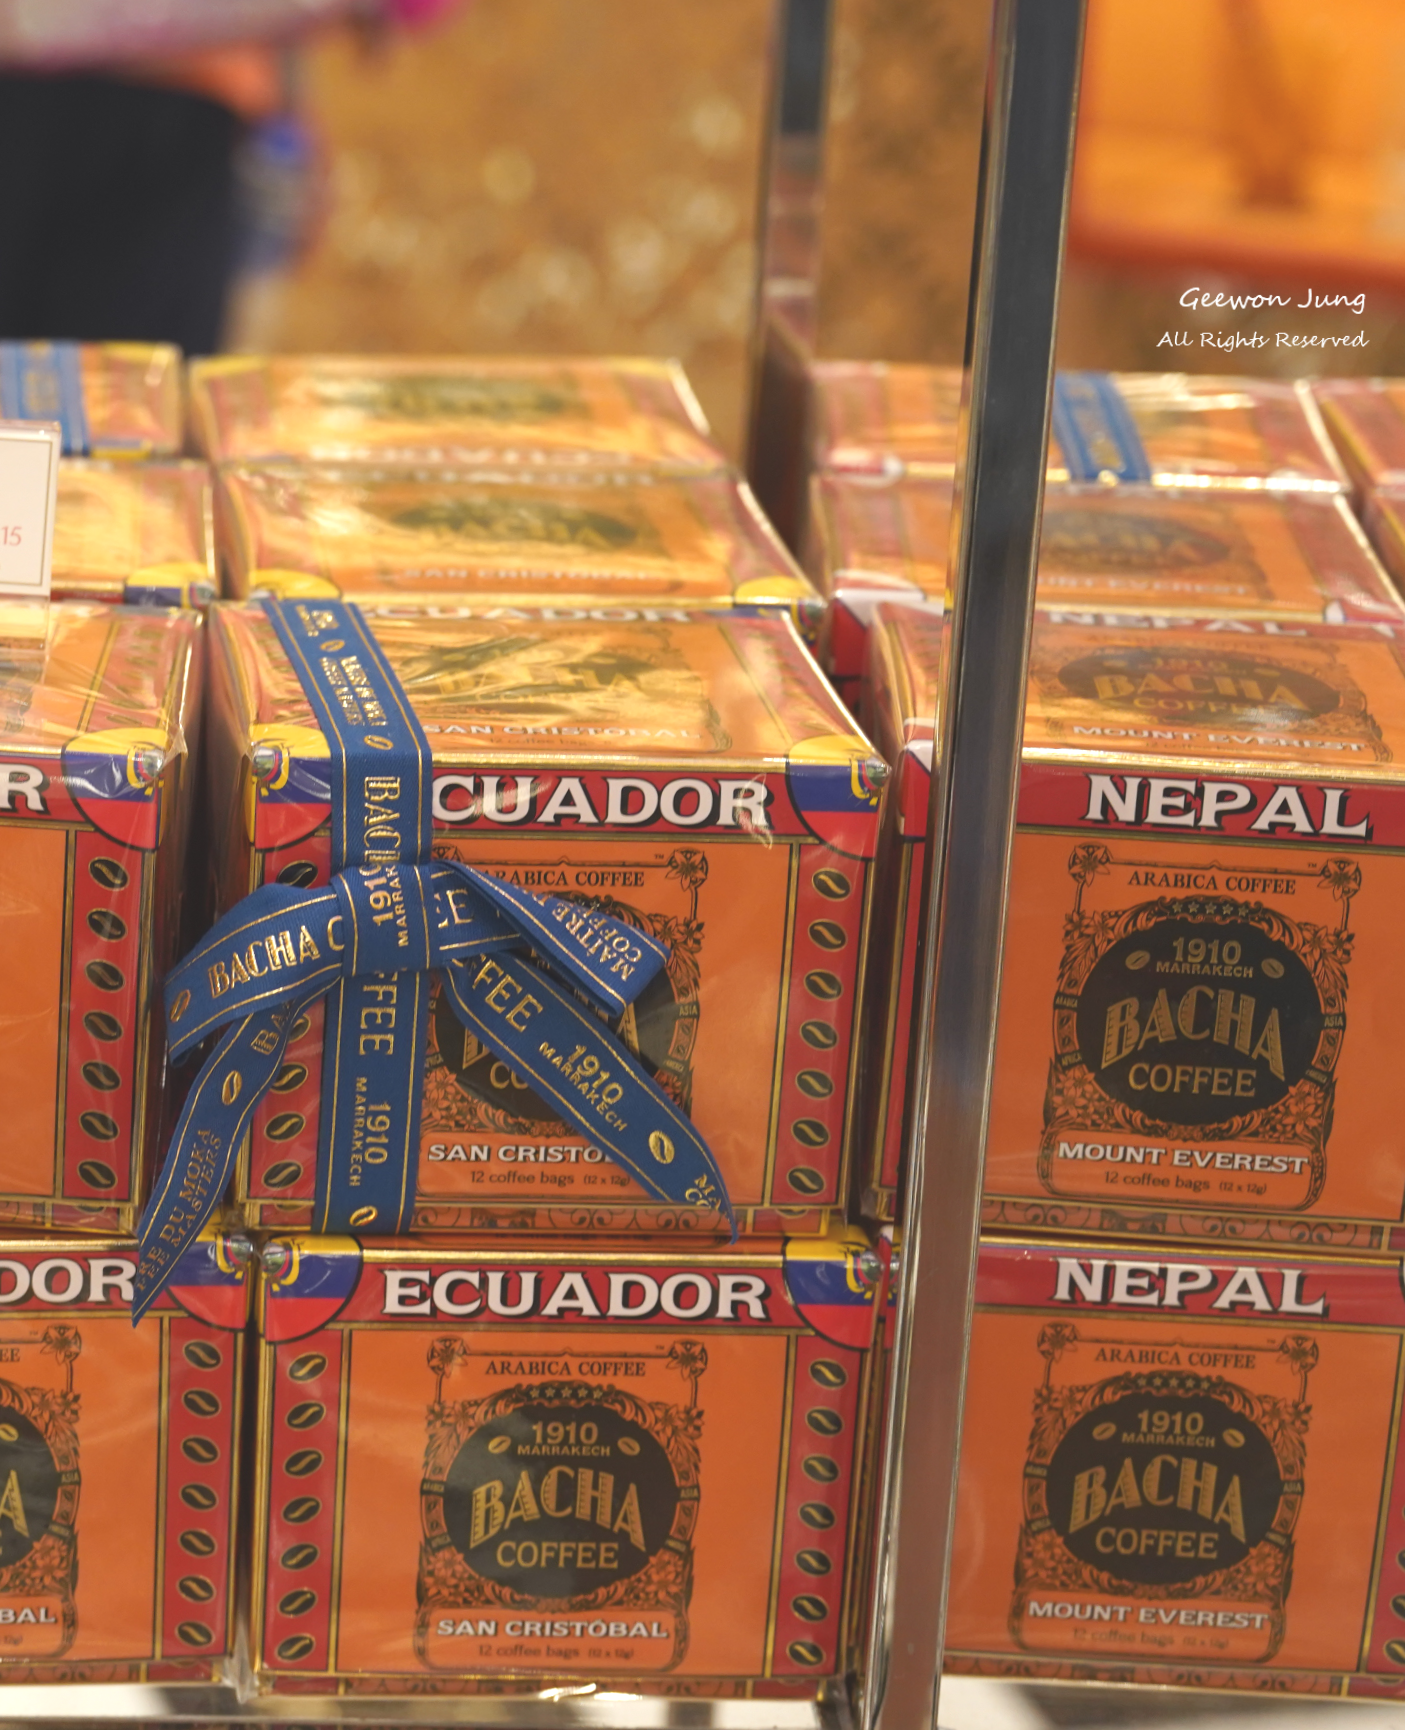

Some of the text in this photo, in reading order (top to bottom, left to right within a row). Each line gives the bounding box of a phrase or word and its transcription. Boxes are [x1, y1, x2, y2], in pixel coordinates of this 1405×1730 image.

[433, 773, 770, 829] CUADOR
[1085, 773, 1372, 840] NEPAL
[575, 871, 645, 888] COFFEE
[1128, 870, 1296, 896] ARABICA COFFEE
[207, 926, 321, 998] BACHA
[1172, 937, 1241, 965] 1910
[1156, 961, 1254, 978] MARRAKECH
[1101, 985, 1285, 1082] BACHA
[539, 1041, 628, 1131] MARRAKECH
[567, 1044, 624, 1104] 1910
[1128, 1063, 1257, 1097] COFFEE
[349, 1077, 368, 1187] MARRAKECH
[364, 1101, 392, 1164] 1910
[428, 1142, 612, 1163] SAN CRISTÓ
[1058, 1141, 1309, 1175] MOUNT EVEREST
[160, 1128, 211, 1241] DU MOKA
[171, 1132, 222, 1248] MASTERS
[471, 1170, 630, 1187] 12 coffee bags (12 12g)
[1104, 1171, 1119, 1185] 12
[1122, 1172, 1170, 1189] coffee
[1175, 1175, 1210, 1193] bags
[381, 1267, 772, 1321] ECUADOR
[1053, 1257, 1329, 1318] NEPAL
[485, 1360, 646, 1377] ARABICA COFFEE
[1094, 1347, 1256, 1370] ARABICA COFFEE
[532, 1421, 598, 1445] 1910
[1137, 1410, 1204, 1434] 1910
[517, 1444, 610, 1457] MARRAKECH
[1121, 1432, 1215, 1448] MARRAKECH
[470, 1465, 646, 1552] BACHA
[1069, 1453, 1246, 1544] BACHA
[497, 1541, 619, 1569] COFFEE
[1096, 1527, 1219, 1559] COFFEE
[437, 1617, 670, 1639] SAN CRISTÓBAL
[1028, 1600, 1270, 1630] MOUNT EVEREST
[479, 1645, 492, 1657] 12
[496, 1645, 541, 1658] coffee
[546, 1645, 580, 1660] bags
